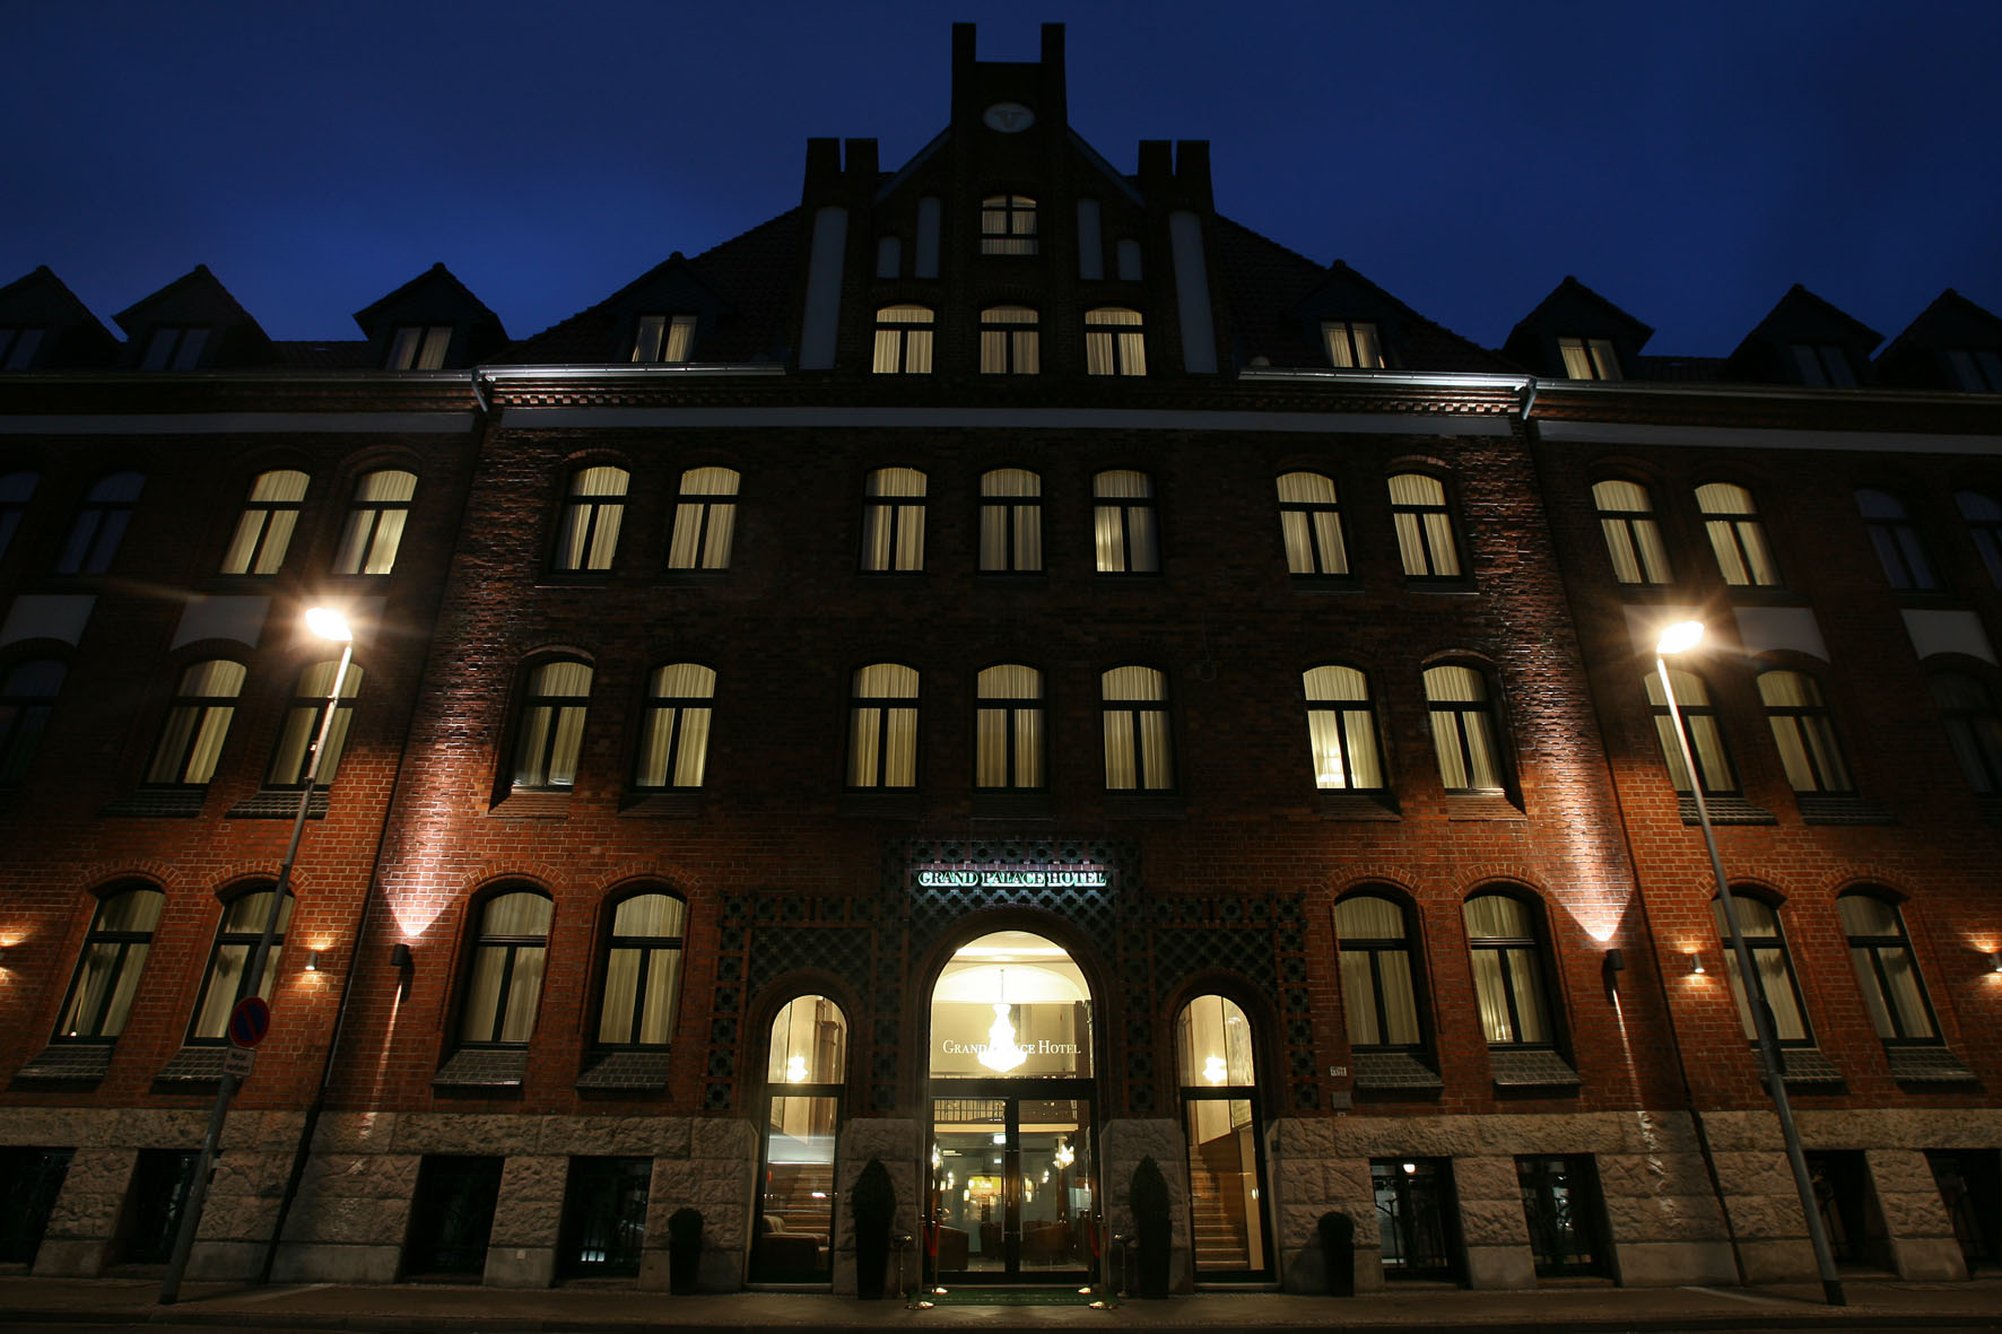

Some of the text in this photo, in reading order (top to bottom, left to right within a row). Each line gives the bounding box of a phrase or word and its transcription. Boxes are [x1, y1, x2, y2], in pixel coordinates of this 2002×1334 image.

[918, 871, 1107, 887] GRAND PALACE HOTEL
